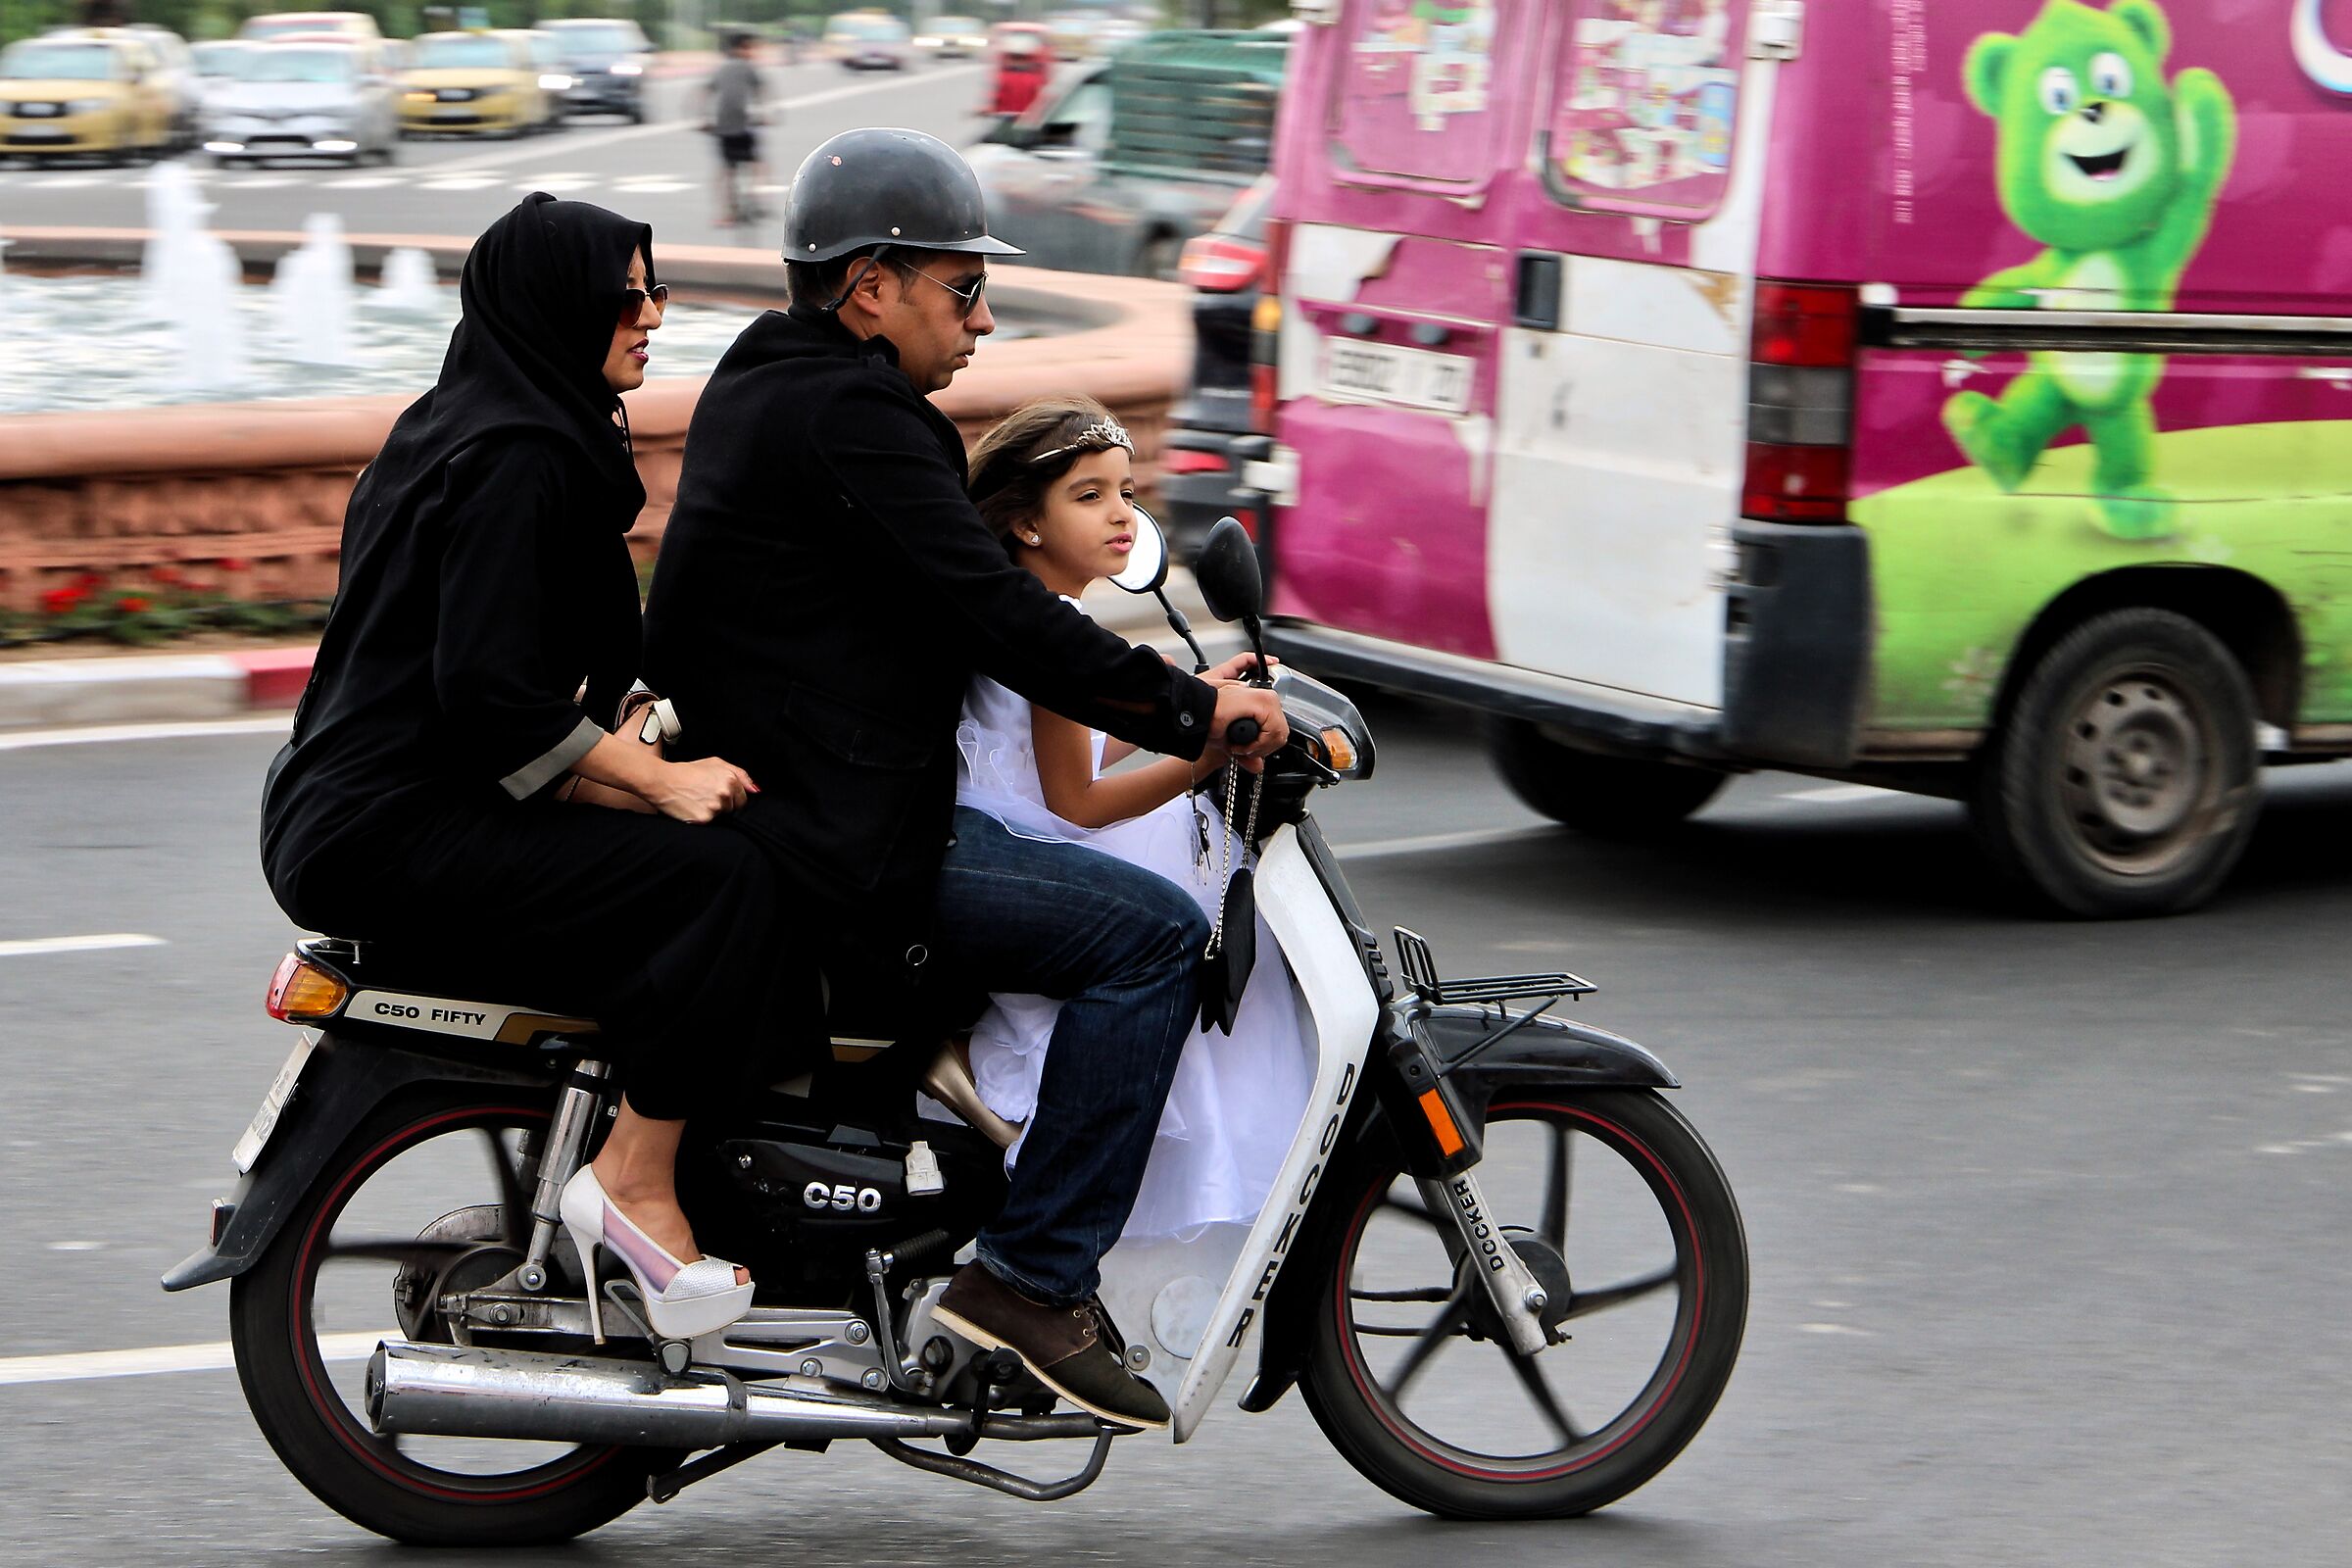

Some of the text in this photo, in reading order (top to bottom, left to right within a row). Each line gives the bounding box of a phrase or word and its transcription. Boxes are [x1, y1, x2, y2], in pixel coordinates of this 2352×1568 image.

[374, 1002, 487, 1026] C50 FIFTY
[804, 1181, 882, 1212] C50
[1226, 1062, 1354, 1348] DOCKER
[1452, 1179, 1505, 1272] DOCKER
